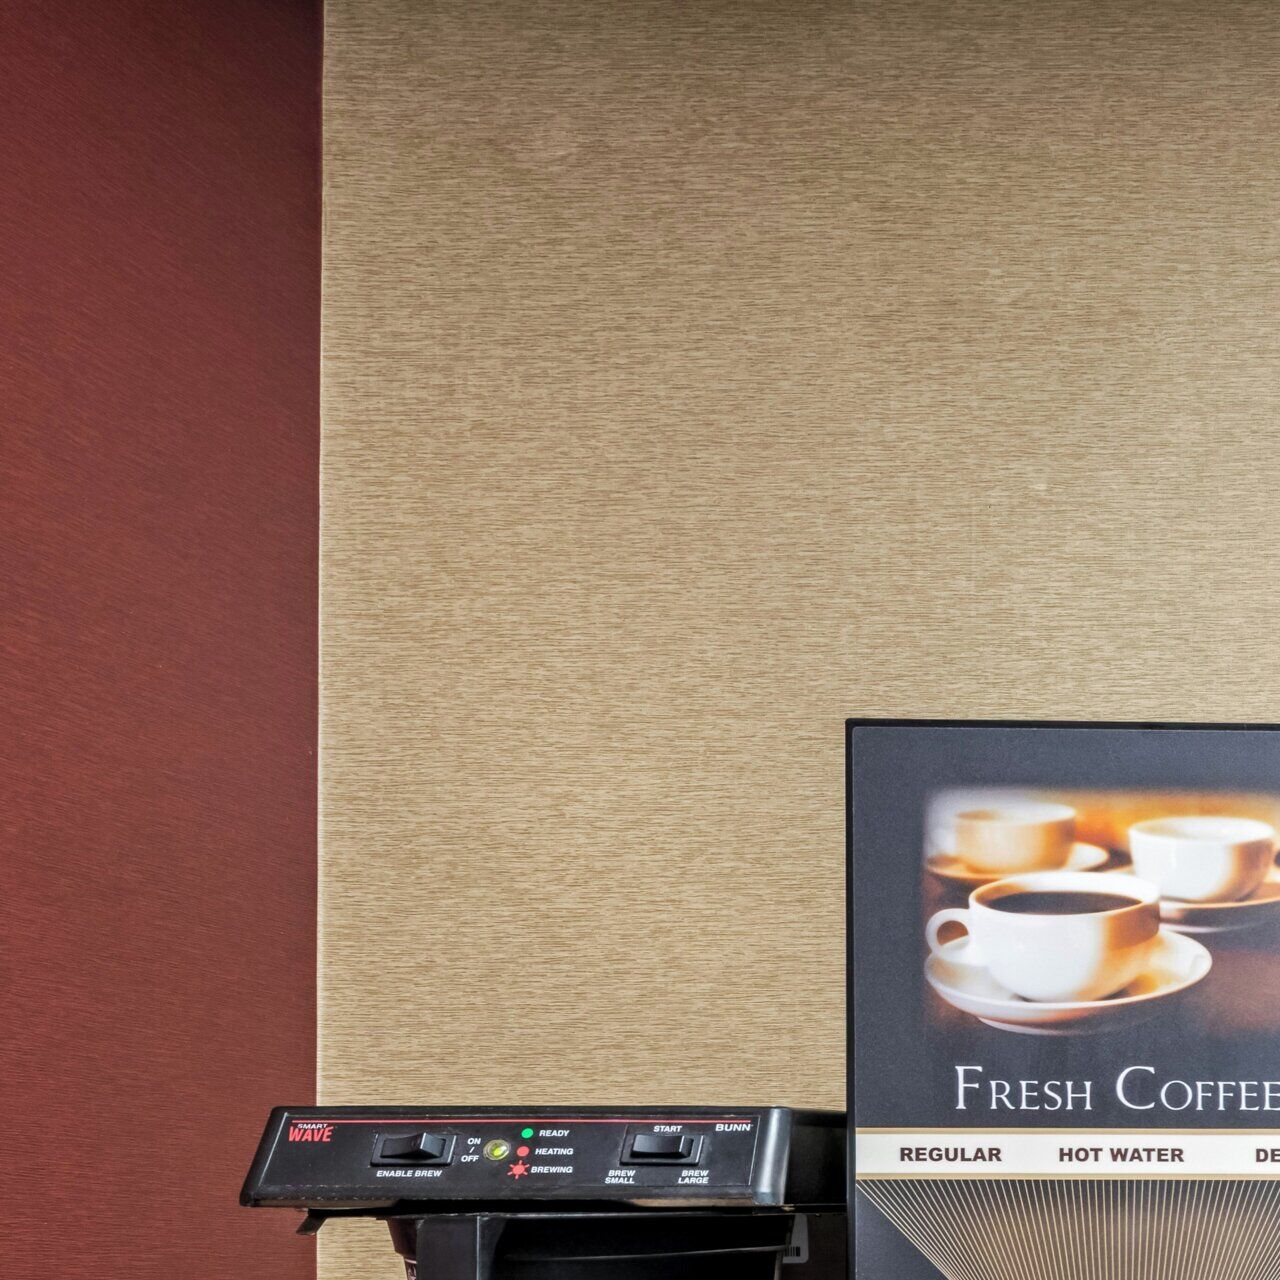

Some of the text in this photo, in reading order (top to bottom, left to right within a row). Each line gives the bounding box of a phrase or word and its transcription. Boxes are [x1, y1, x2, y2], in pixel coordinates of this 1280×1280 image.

[653, 1125, 683, 1133] START
[715, 1124, 751, 1132] BUNN
[288, 1126, 335, 1142] WAVE
[539, 1129, 570, 1137] READY
[467, 1137, 482, 1145] ON
[535, 1147, 574, 1155] HEATING
[899, 1147, 1003, 1163] REGULAR
[1058, 1147, 1185, 1163] HOT WATER
[460, 1154, 480, 1163] OFF
[376, 1170, 443, 1178] ENABLE BREW
[530, 1166, 573, 1174] BREWING
